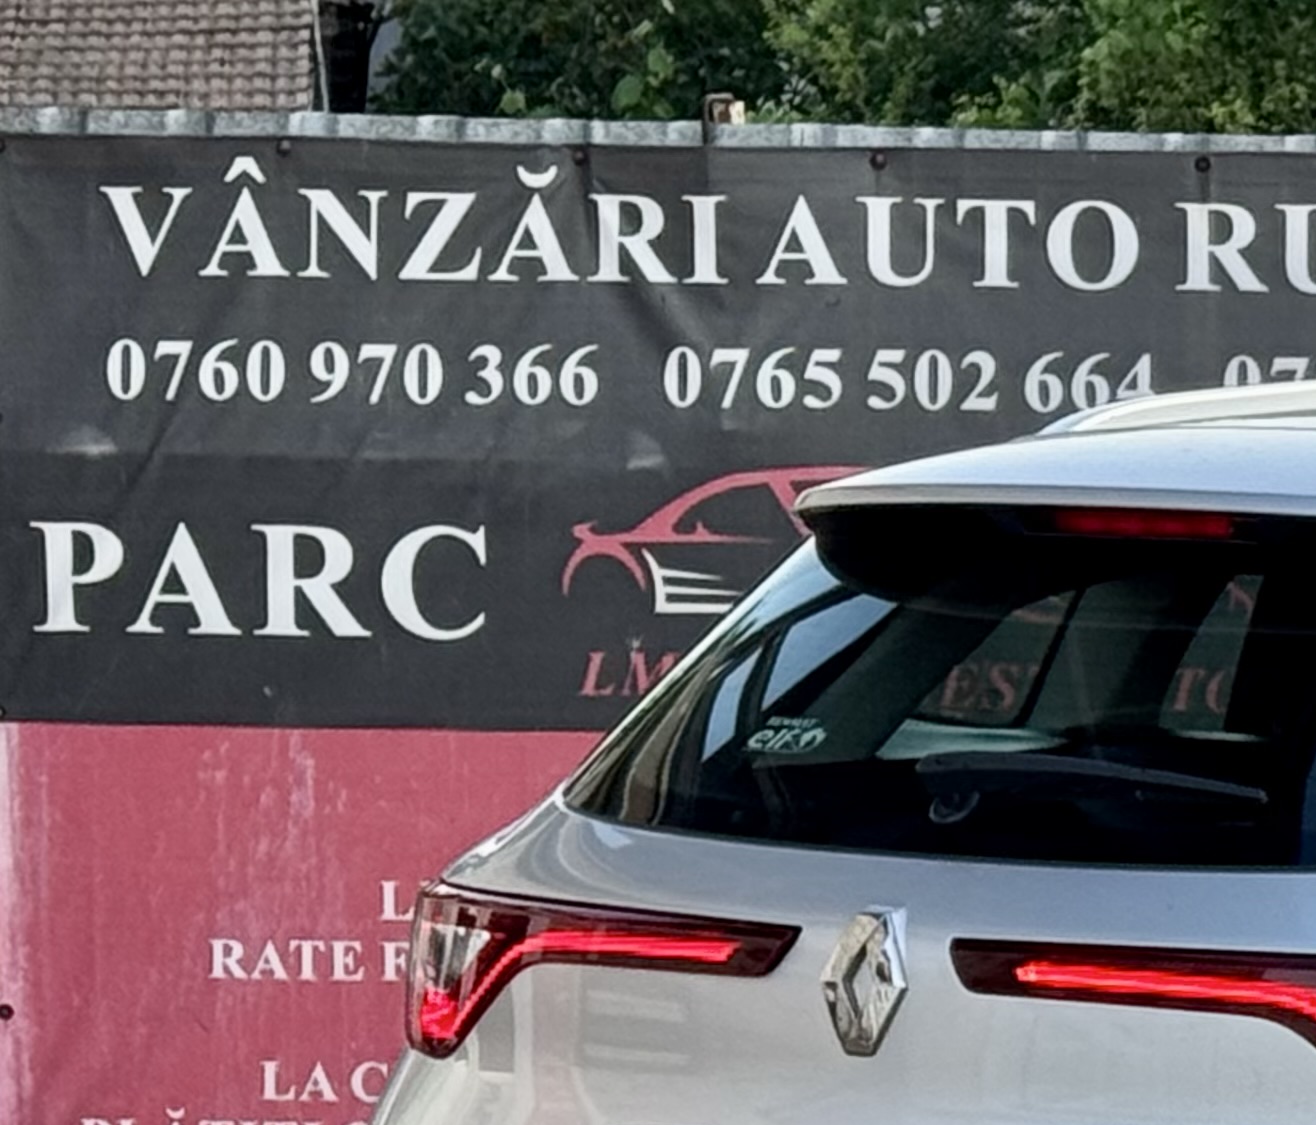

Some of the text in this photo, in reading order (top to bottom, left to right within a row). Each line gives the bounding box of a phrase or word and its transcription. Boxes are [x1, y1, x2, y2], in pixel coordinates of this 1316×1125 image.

[99, 156, 729, 284] VÂNZĂRI
[755, 194, 1140, 291] AUTO
[105, 338, 286, 402] 0760
[309, 340, 444, 405] 970
[464, 343, 599, 406] 366
[662, 345, 843, 409] 0765
[866, 348, 998, 411] 502
[1024, 351, 1157, 413] 664
[29, 521, 487, 641] PARC
[209, 939, 363, 981] RATE
[260, 1060, 339, 1102] LA
